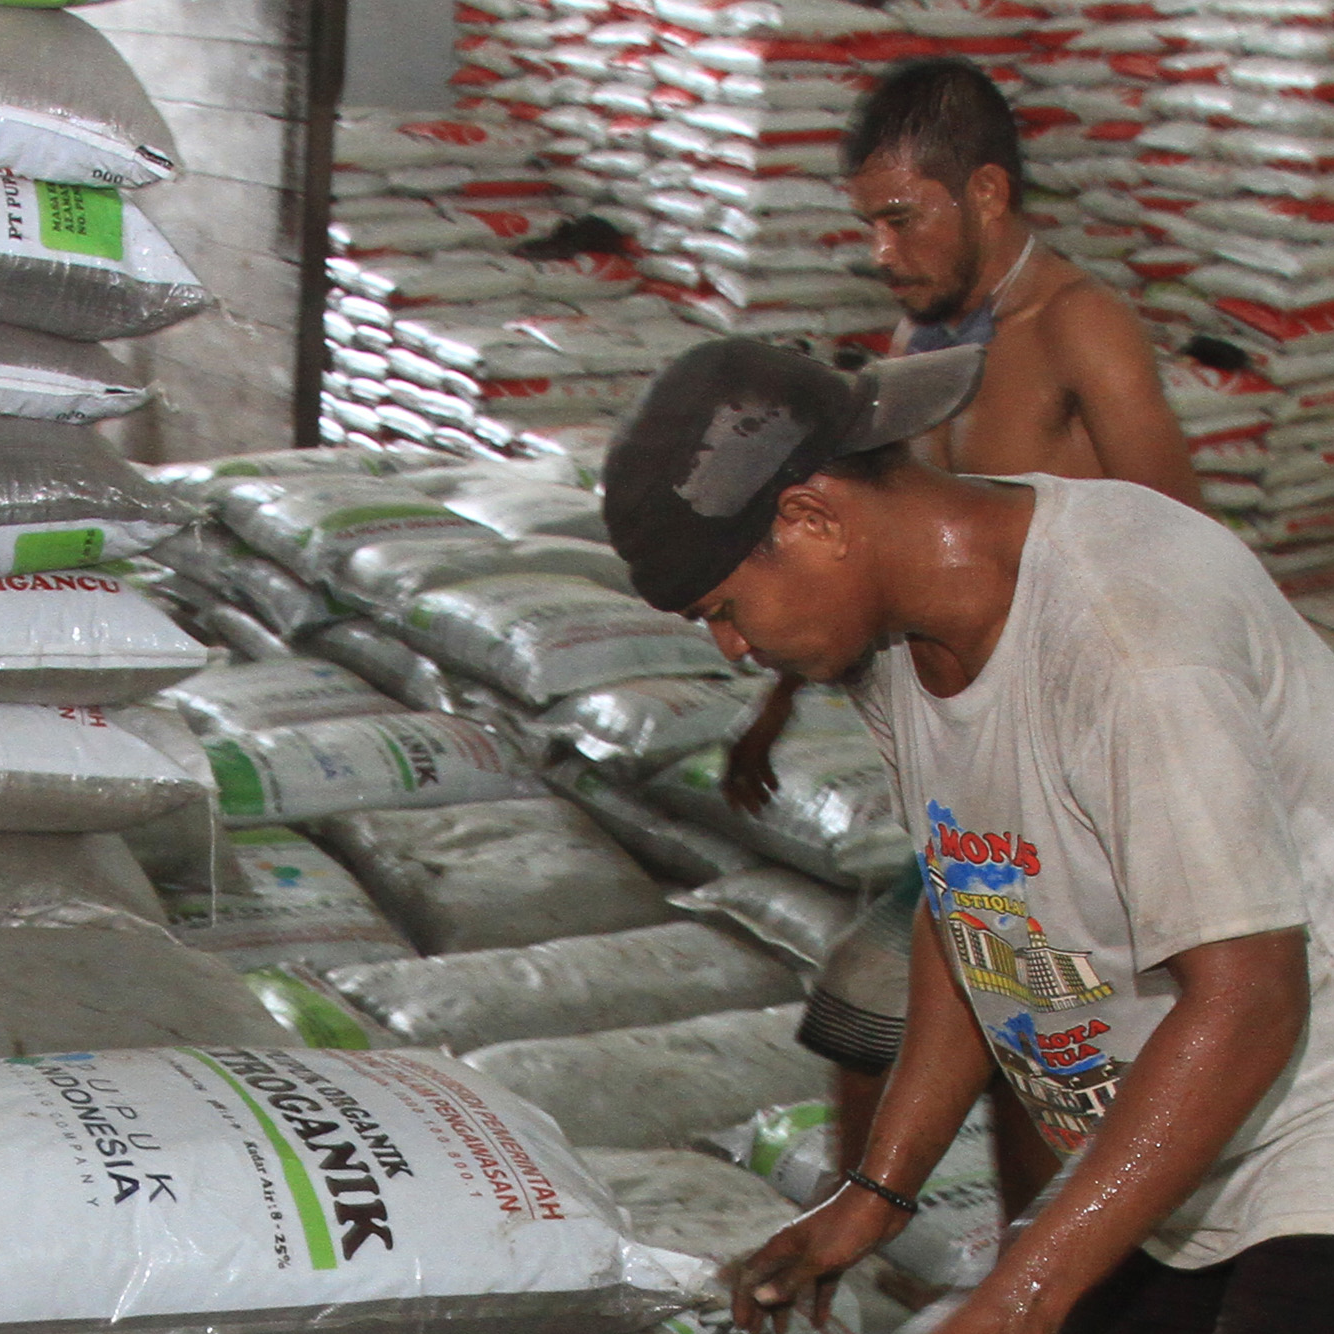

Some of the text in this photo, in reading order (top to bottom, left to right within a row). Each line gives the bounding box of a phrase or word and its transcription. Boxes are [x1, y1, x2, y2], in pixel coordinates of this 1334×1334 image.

[8, 213, 23, 241] PT
[937, 822, 1042, 877] MONS
[1036, 1018, 1112, 1050] KOTA
[1040, 1042, 1101, 1069] TUA
[316, 1085, 415, 1180] ORGANIK
[432, 1098, 523, 1213] PENGAWASAN
[479, 1108, 567, 1221] PEMERINTAH
[260, 1176, 277, 1203] Air
[273, 1232, 293, 1271] 25%
